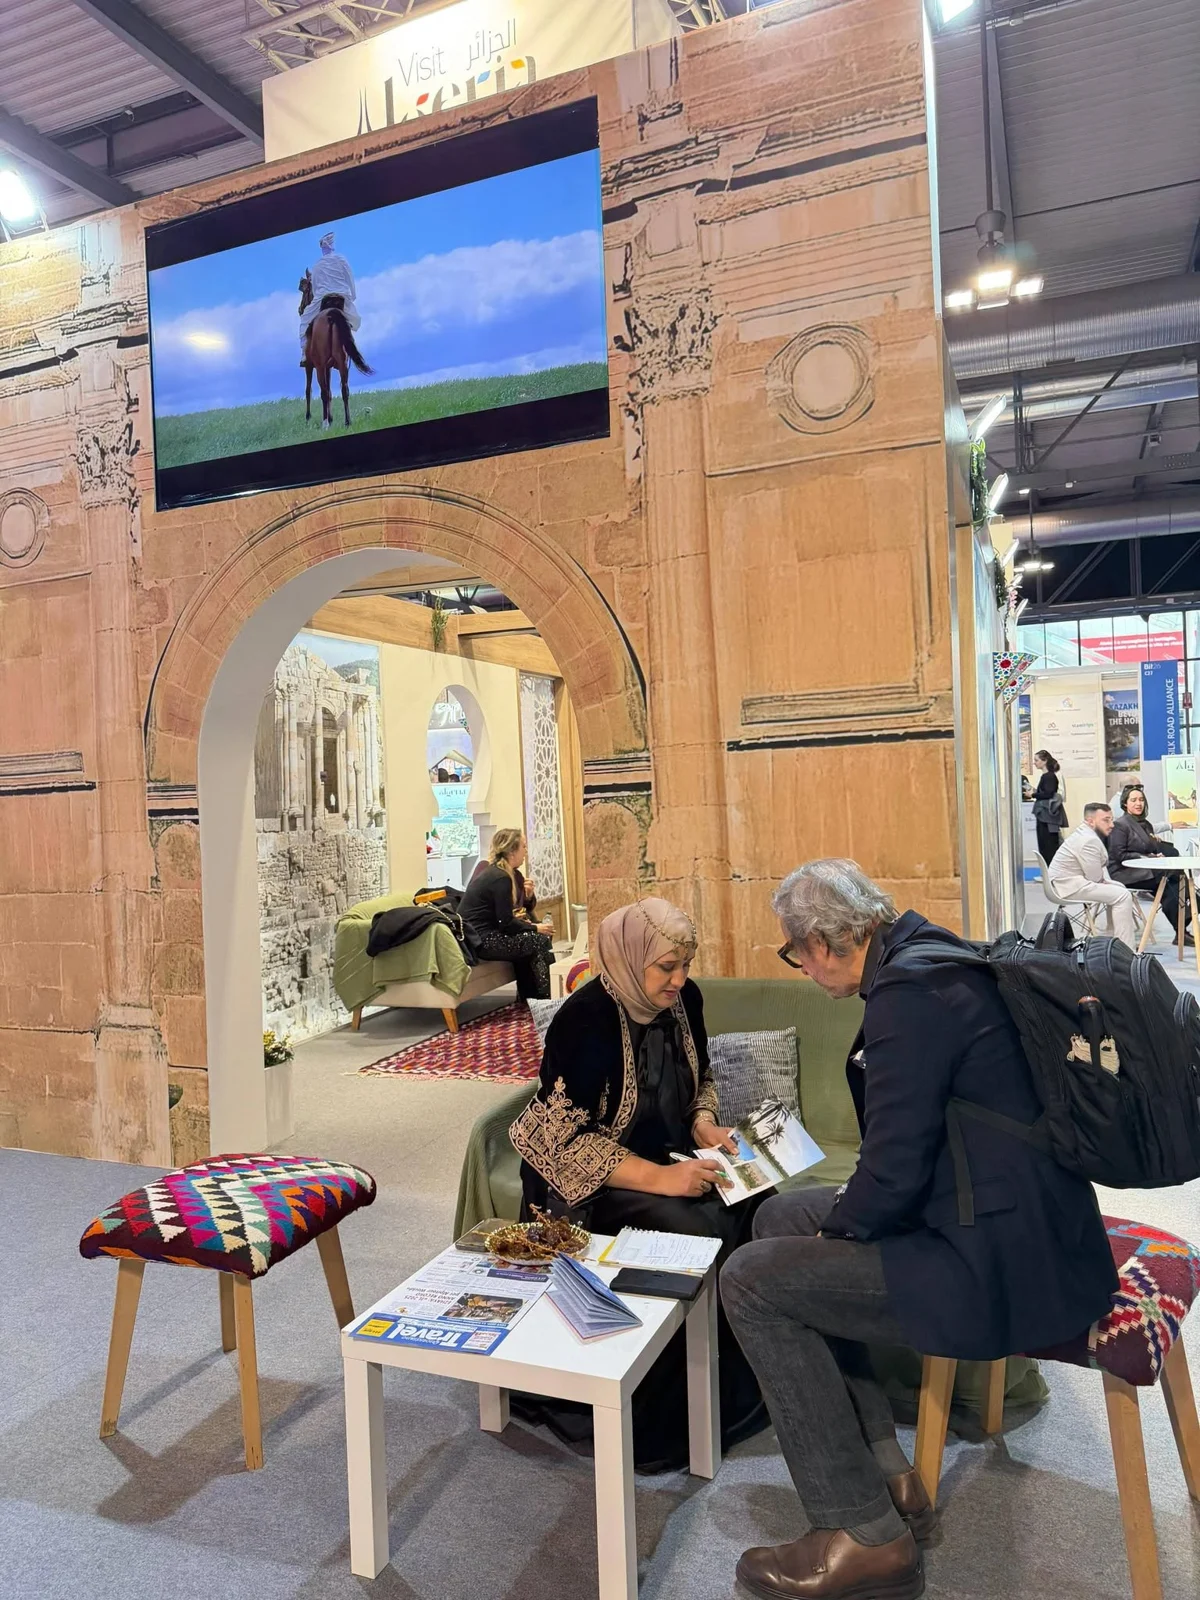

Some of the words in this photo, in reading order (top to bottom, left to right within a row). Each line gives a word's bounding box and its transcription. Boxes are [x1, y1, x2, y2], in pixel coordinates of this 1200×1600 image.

[466, 18, 517, 71] الجزائر
[397, 46, 447, 87] Visit
[1165, 678, 1174, 715] ALLIANCE
[1108, 718, 1122, 726] THE
[1166, 717, 1175, 739] ROAD
[387, 1323, 461, 1347] Travel
